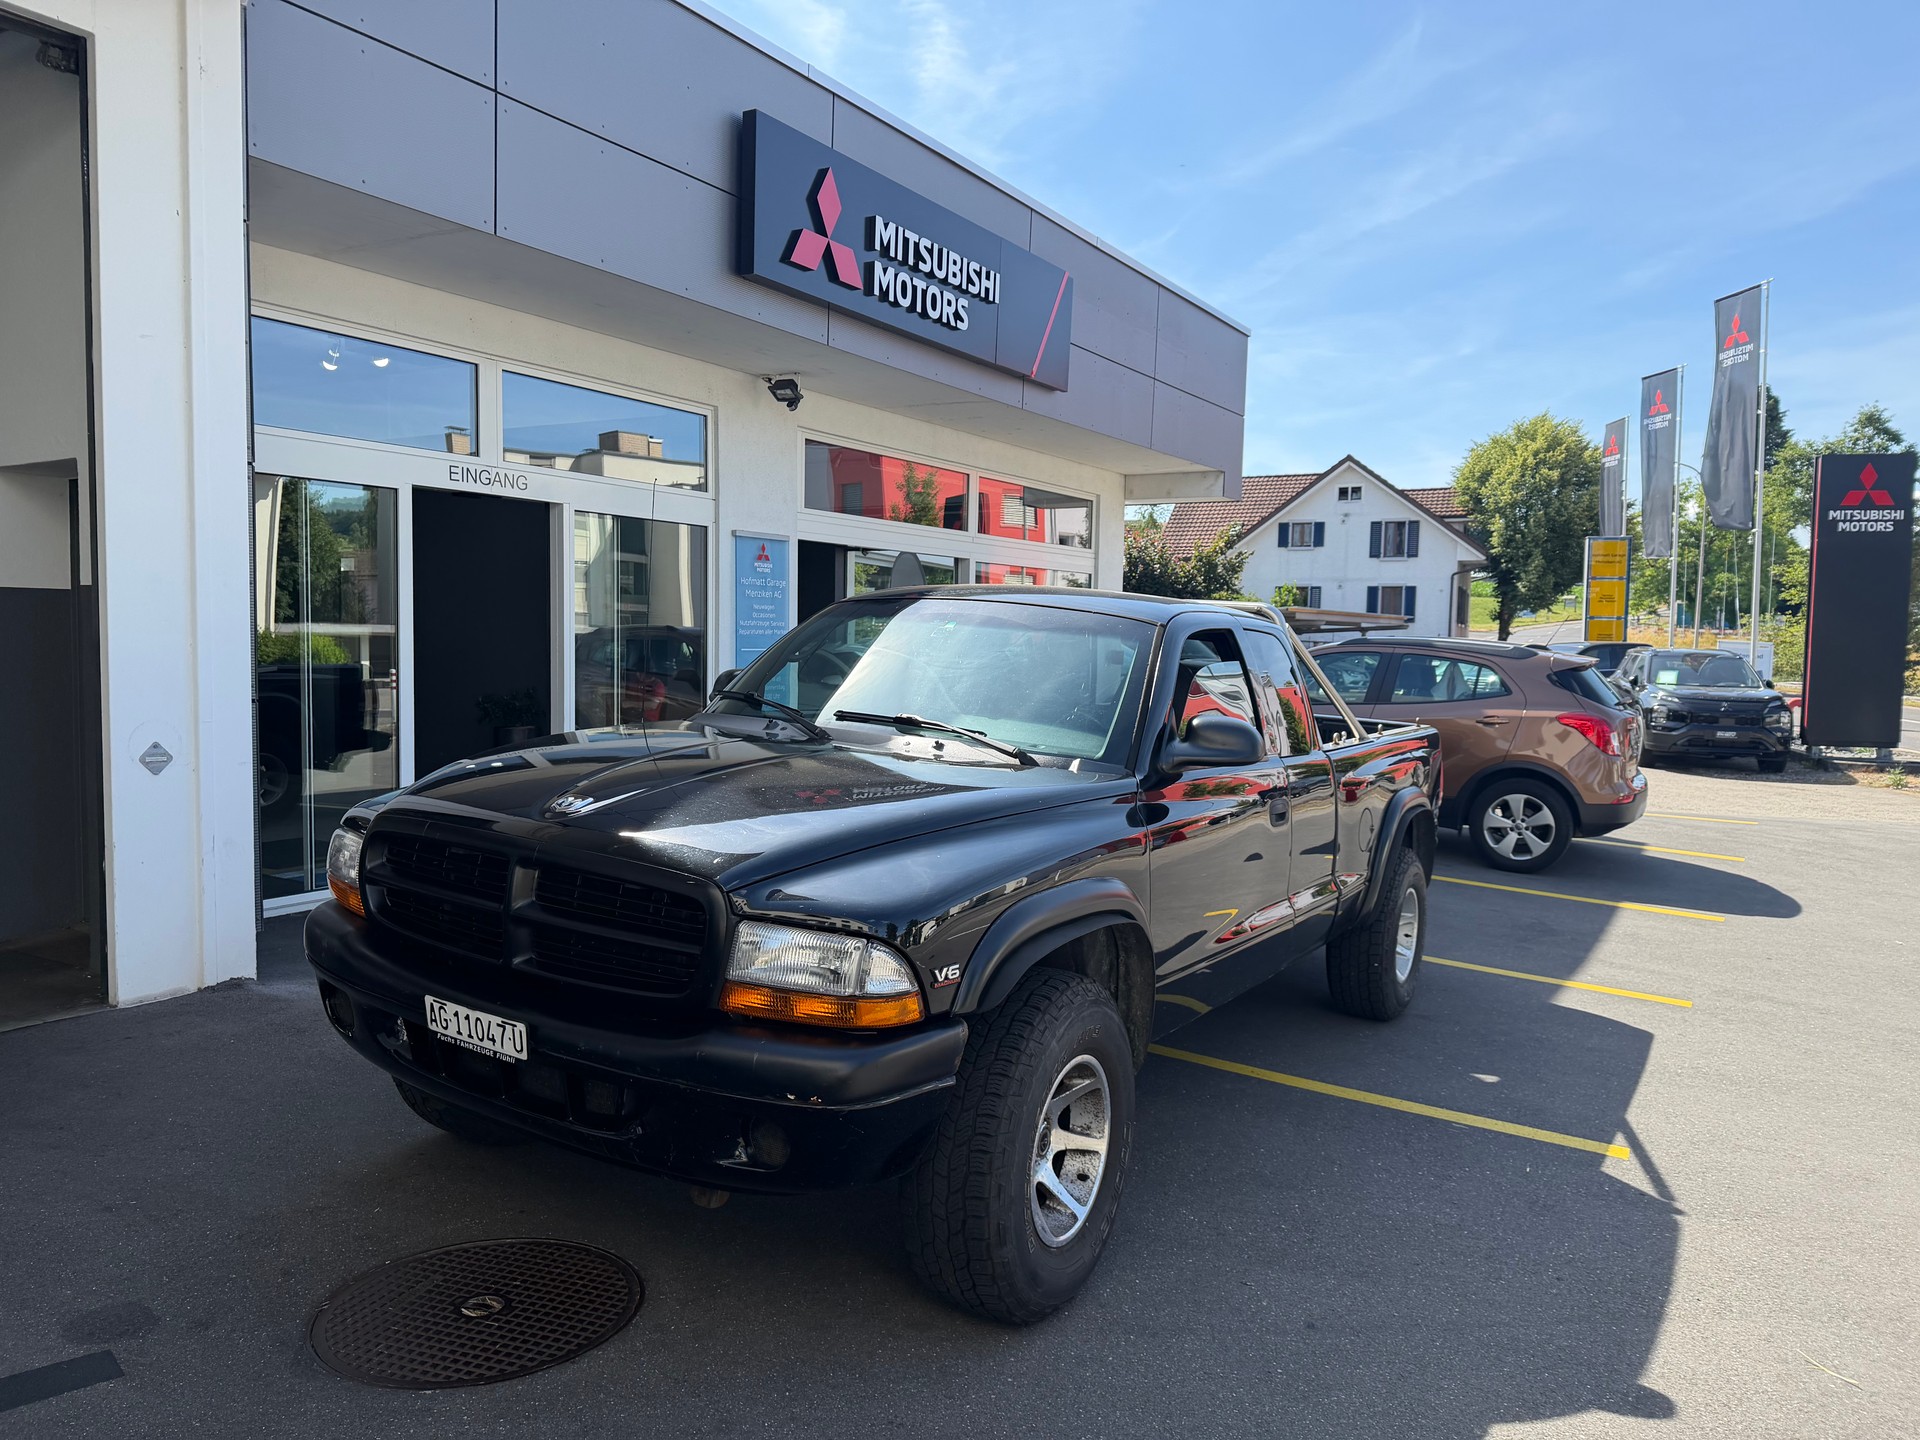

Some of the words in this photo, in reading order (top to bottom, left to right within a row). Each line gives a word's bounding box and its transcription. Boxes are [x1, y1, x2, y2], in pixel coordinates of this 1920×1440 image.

[874, 214, 1001, 304] MITSUBISHI
[873, 260, 969, 331] MOTORS
[448, 464, 528, 491] EINGANG
[1828, 509, 1905, 520] MITSUBISHI
[1837, 521, 1895, 532] MOTORS
[740, 577, 766, 587] Hofmatt
[766, 578, 787, 589] Garage
[745, 589, 773, 598] Menziken
[773, 590, 782, 599] AG
[934, 963, 961, 982] V6
[437, 1033, 455, 1044] Fuchs
[456, 1040, 494, 1057] FAHRZEUGE
[496, 1052, 516, 1064] Flühli
